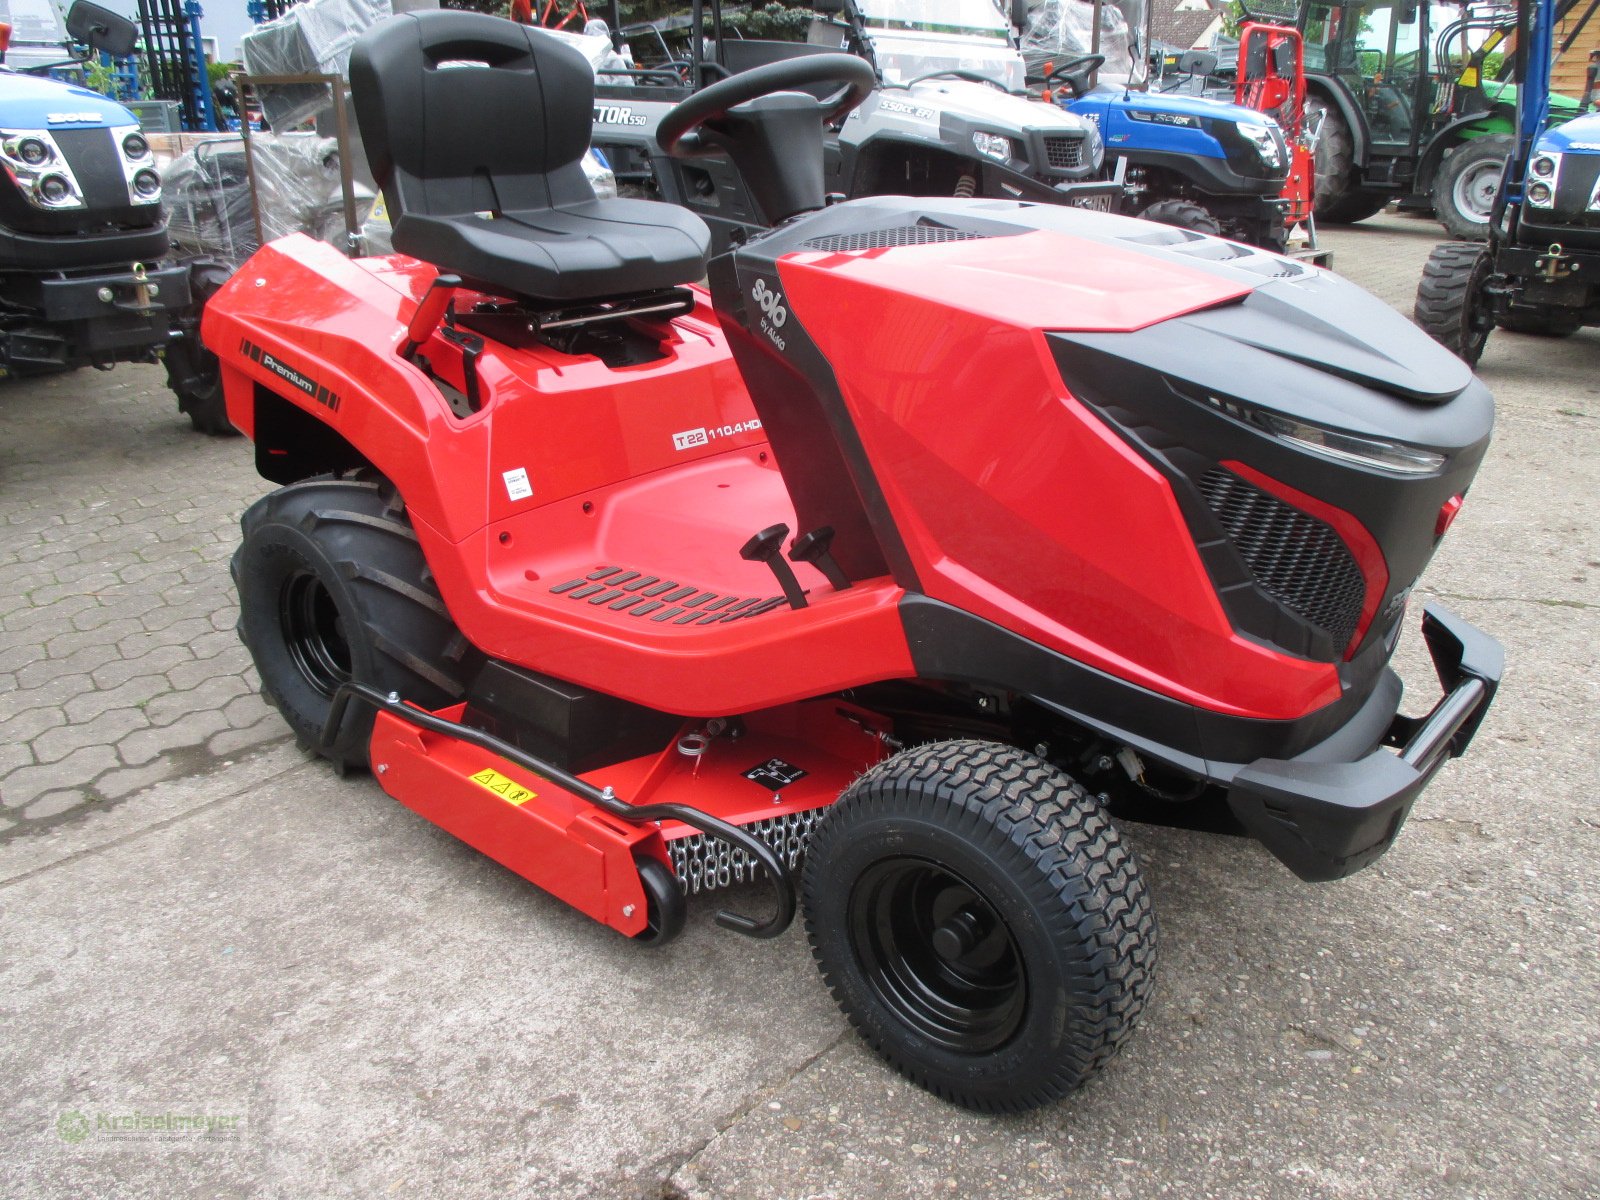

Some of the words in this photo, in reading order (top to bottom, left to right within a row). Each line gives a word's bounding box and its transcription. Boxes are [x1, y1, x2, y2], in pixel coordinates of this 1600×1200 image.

[752, 279, 787, 328] solo
[263, 354, 313, 392] Premium
[676, 436, 685, 447] T
[687, 432, 705, 445] 22
[709, 423, 743, 439] 110.4
